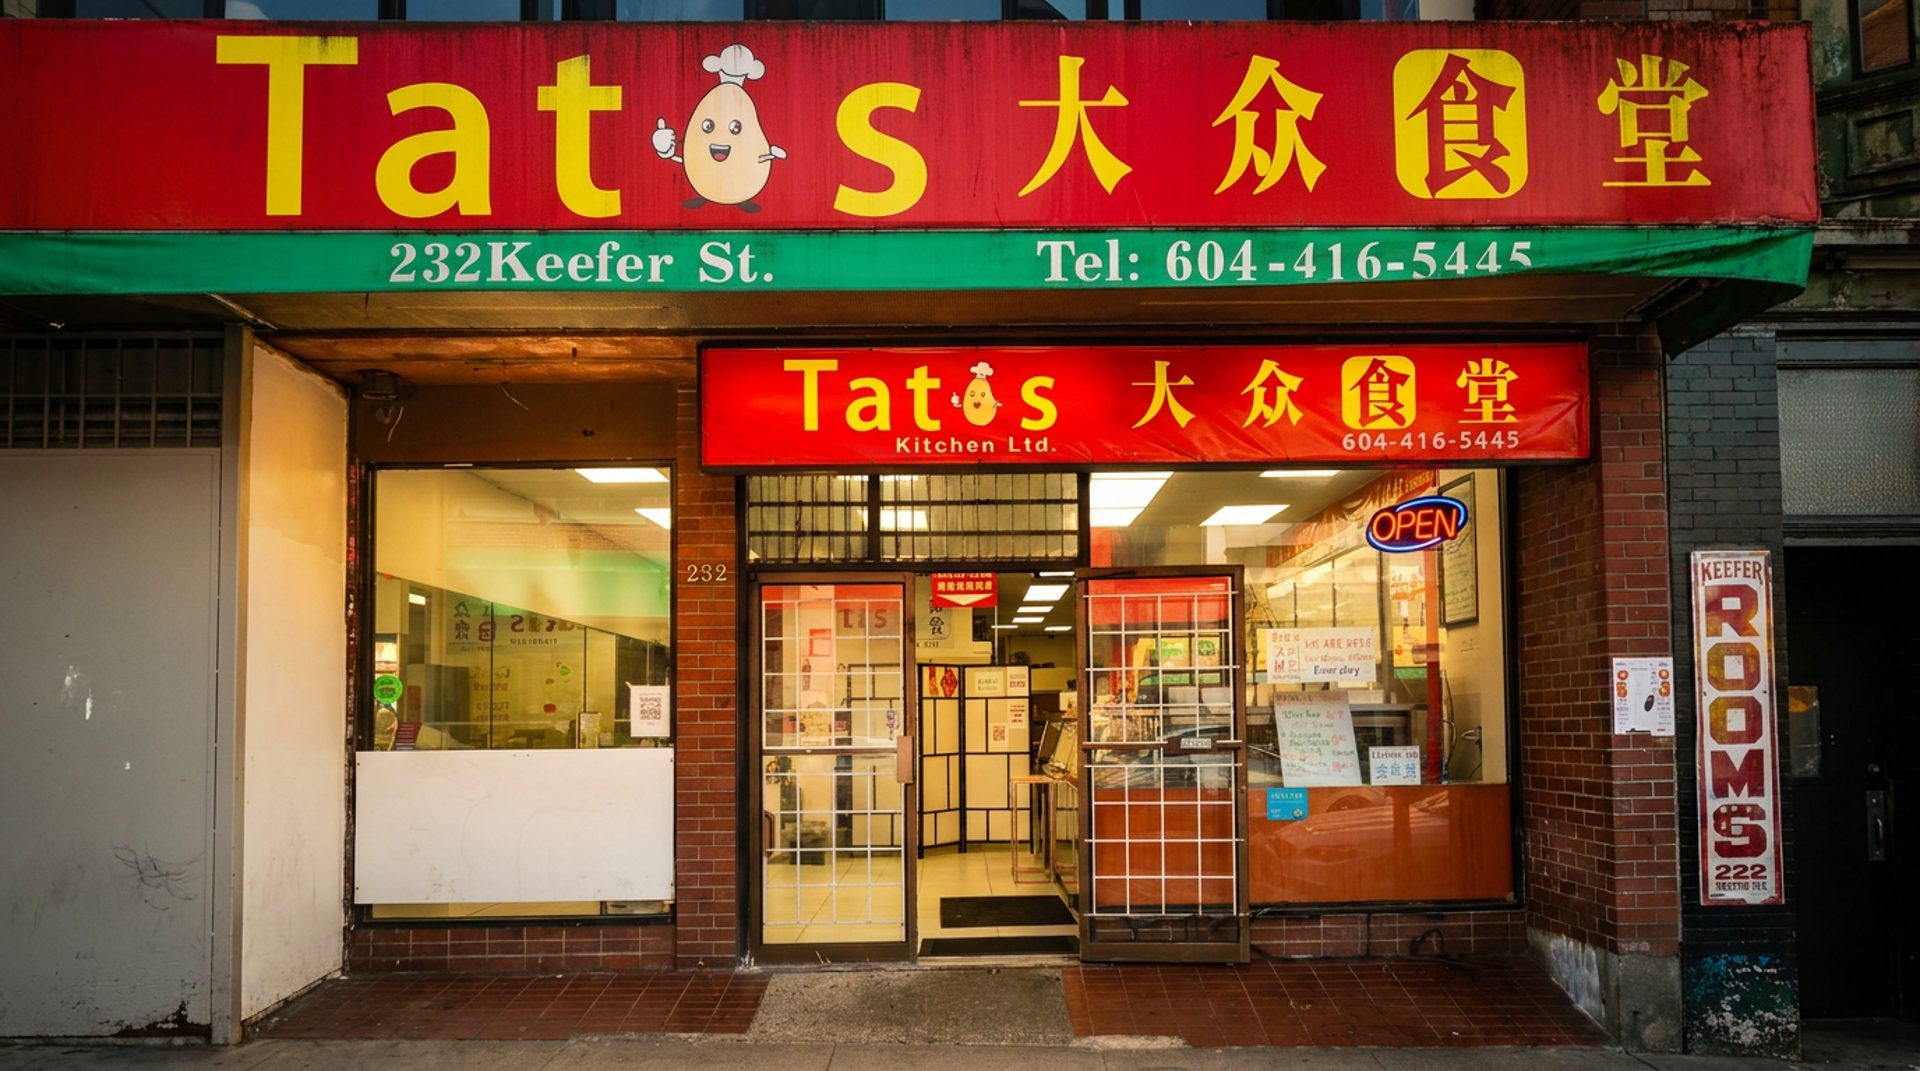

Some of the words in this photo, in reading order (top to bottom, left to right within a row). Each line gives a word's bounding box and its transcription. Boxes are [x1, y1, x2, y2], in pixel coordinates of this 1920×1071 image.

[1018, 49, 1712, 200] 大众食堂
[699, 241, 774, 283] St.
[1036, 239, 1140, 282] Tel:
[1165, 239, 1533, 280] 604-416-5445
[1131, 356, 1519, 430] 大众食堂
[895, 436, 995, 453] Kitchen
[1007, 436, 1057, 453] Ltd.
[1341, 429, 1520, 451] 604-416-5445
[1372, 508, 1458, 541] OPEN
[687, 564, 727, 582] 232
[1701, 560, 1763, 585] KEEFER
[1704, 583, 1768, 858] ROOMS
[1714, 863, 1767, 881] 222
